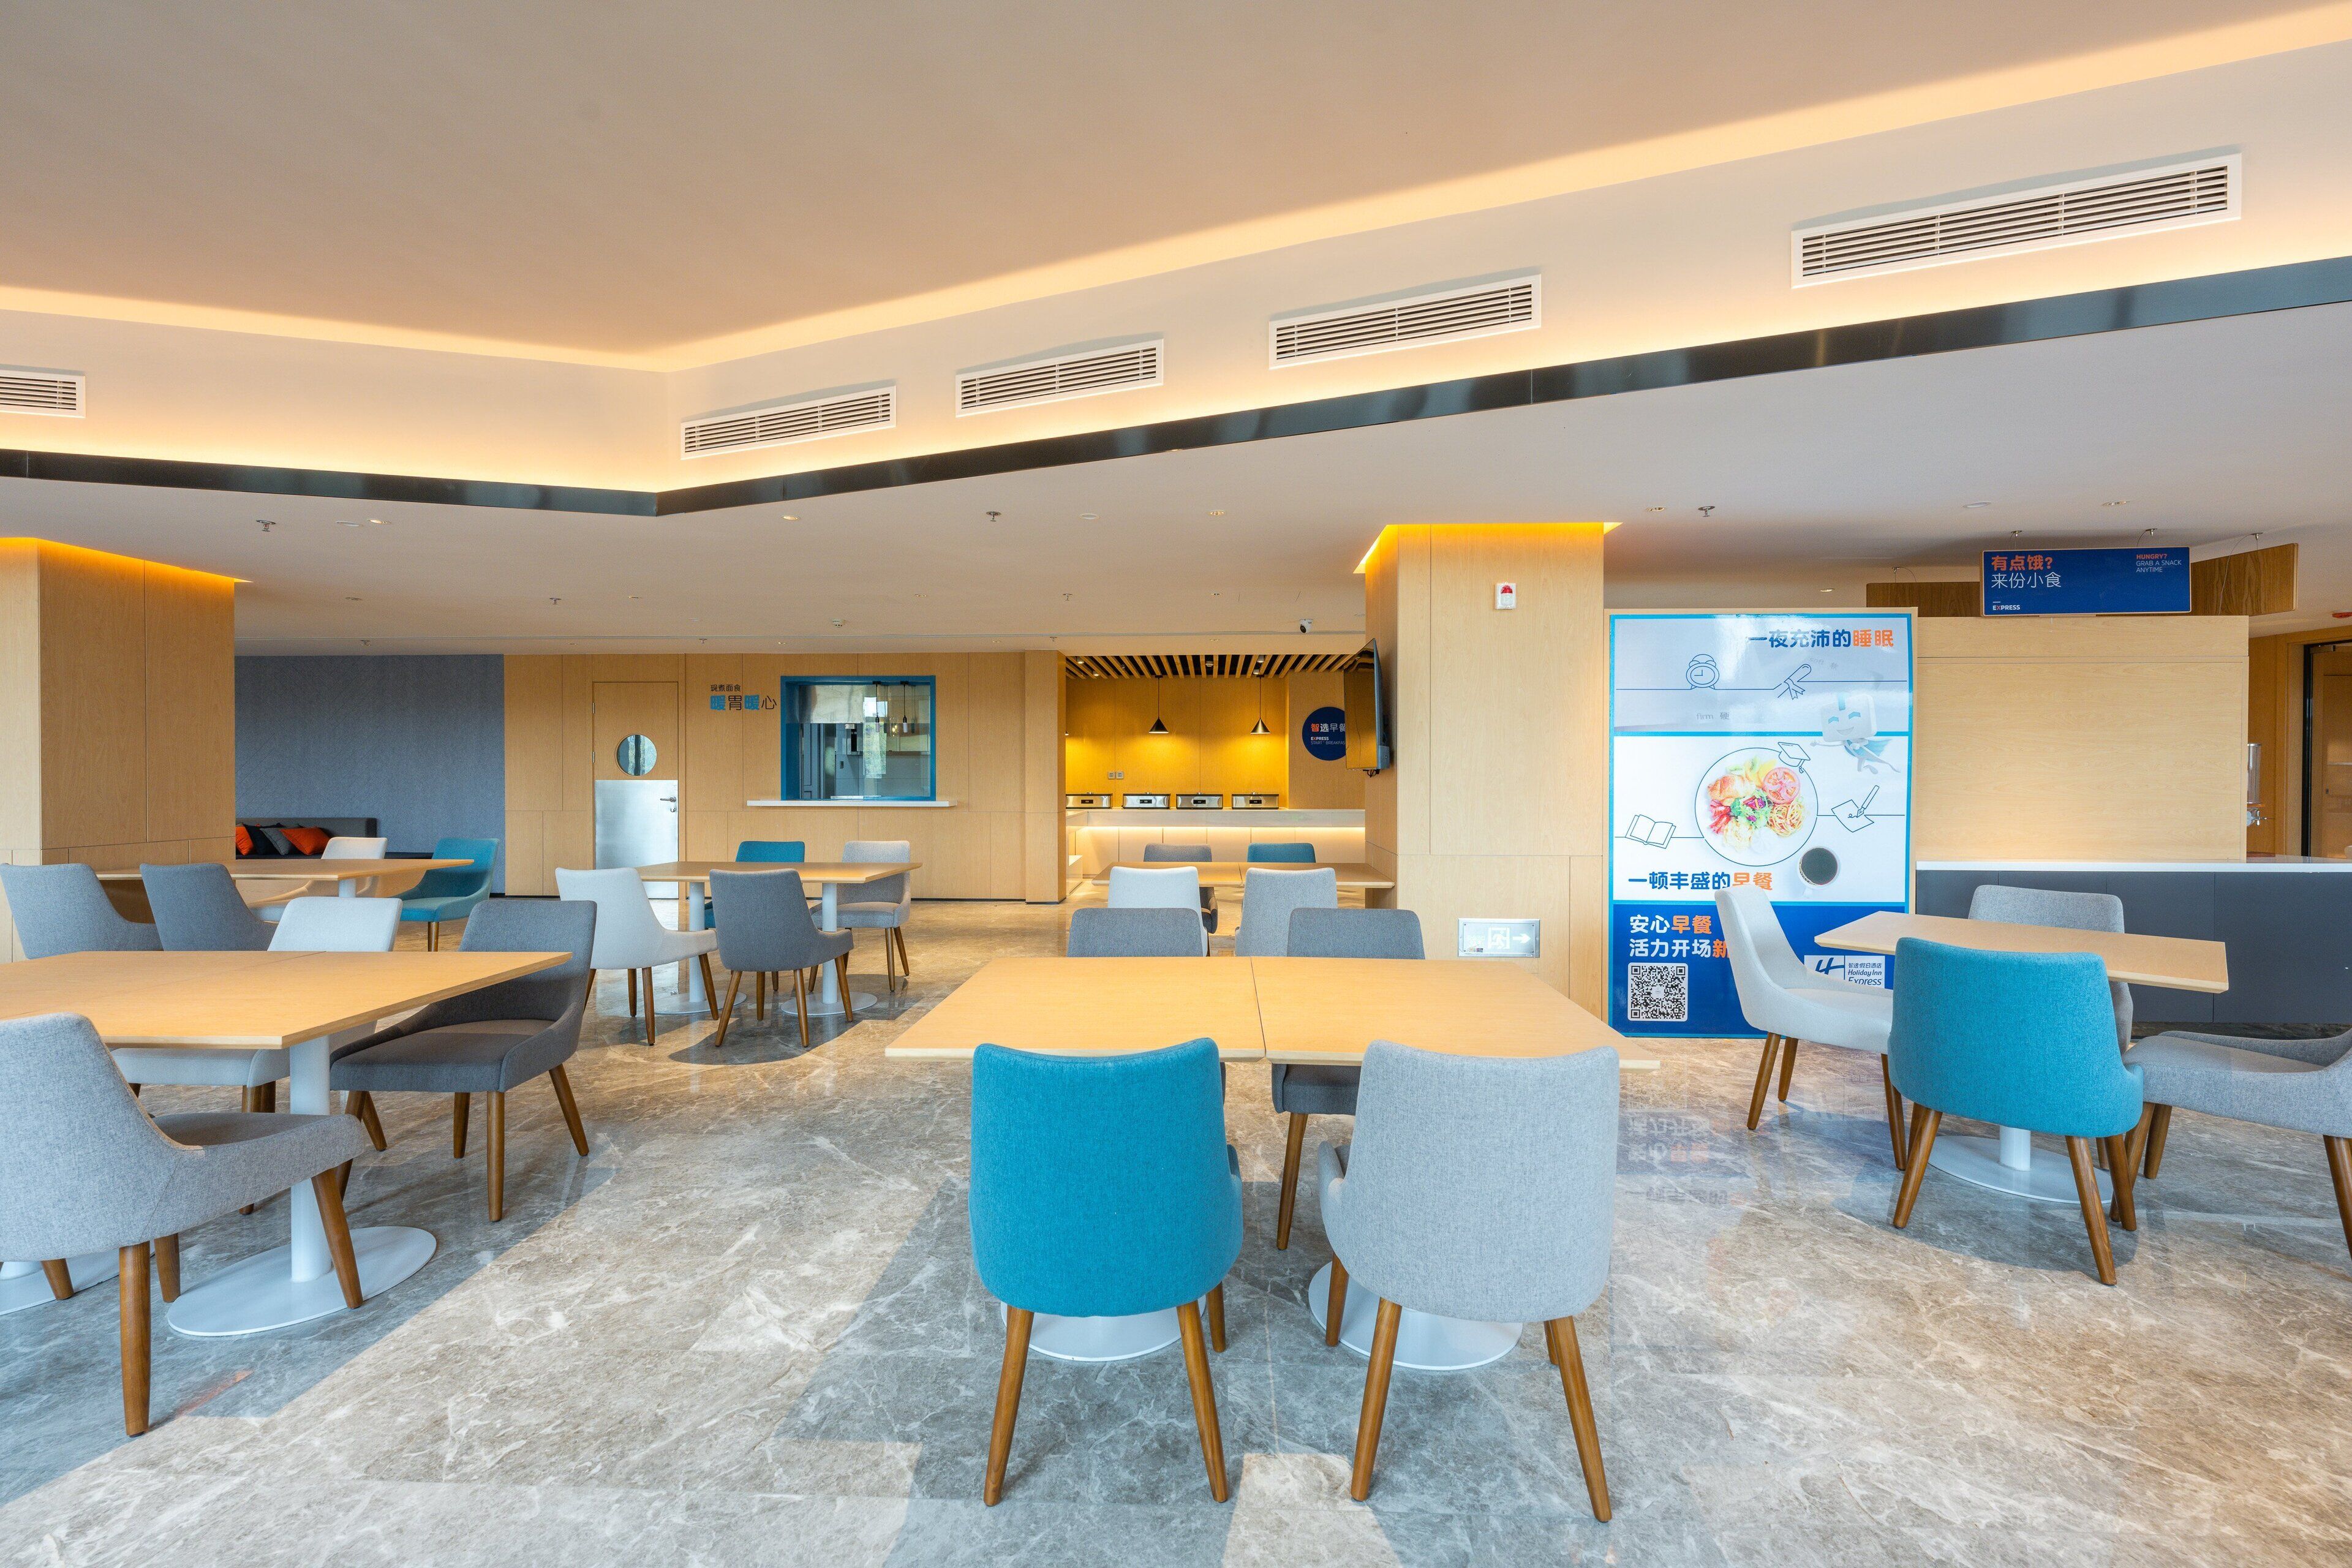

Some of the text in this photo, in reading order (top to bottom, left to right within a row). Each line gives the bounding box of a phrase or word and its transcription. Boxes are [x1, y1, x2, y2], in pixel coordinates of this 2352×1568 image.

[1991, 571, 2062, 589] 来份小食
[1748, 628, 1894, 648] 一夜充沛的睡眠
[710, 695, 777, 711] 暖胃暖心
[1628, 871, 1773, 891] 一顿丰盛的早餐
[1629, 914, 1713, 935] 安心早餐
